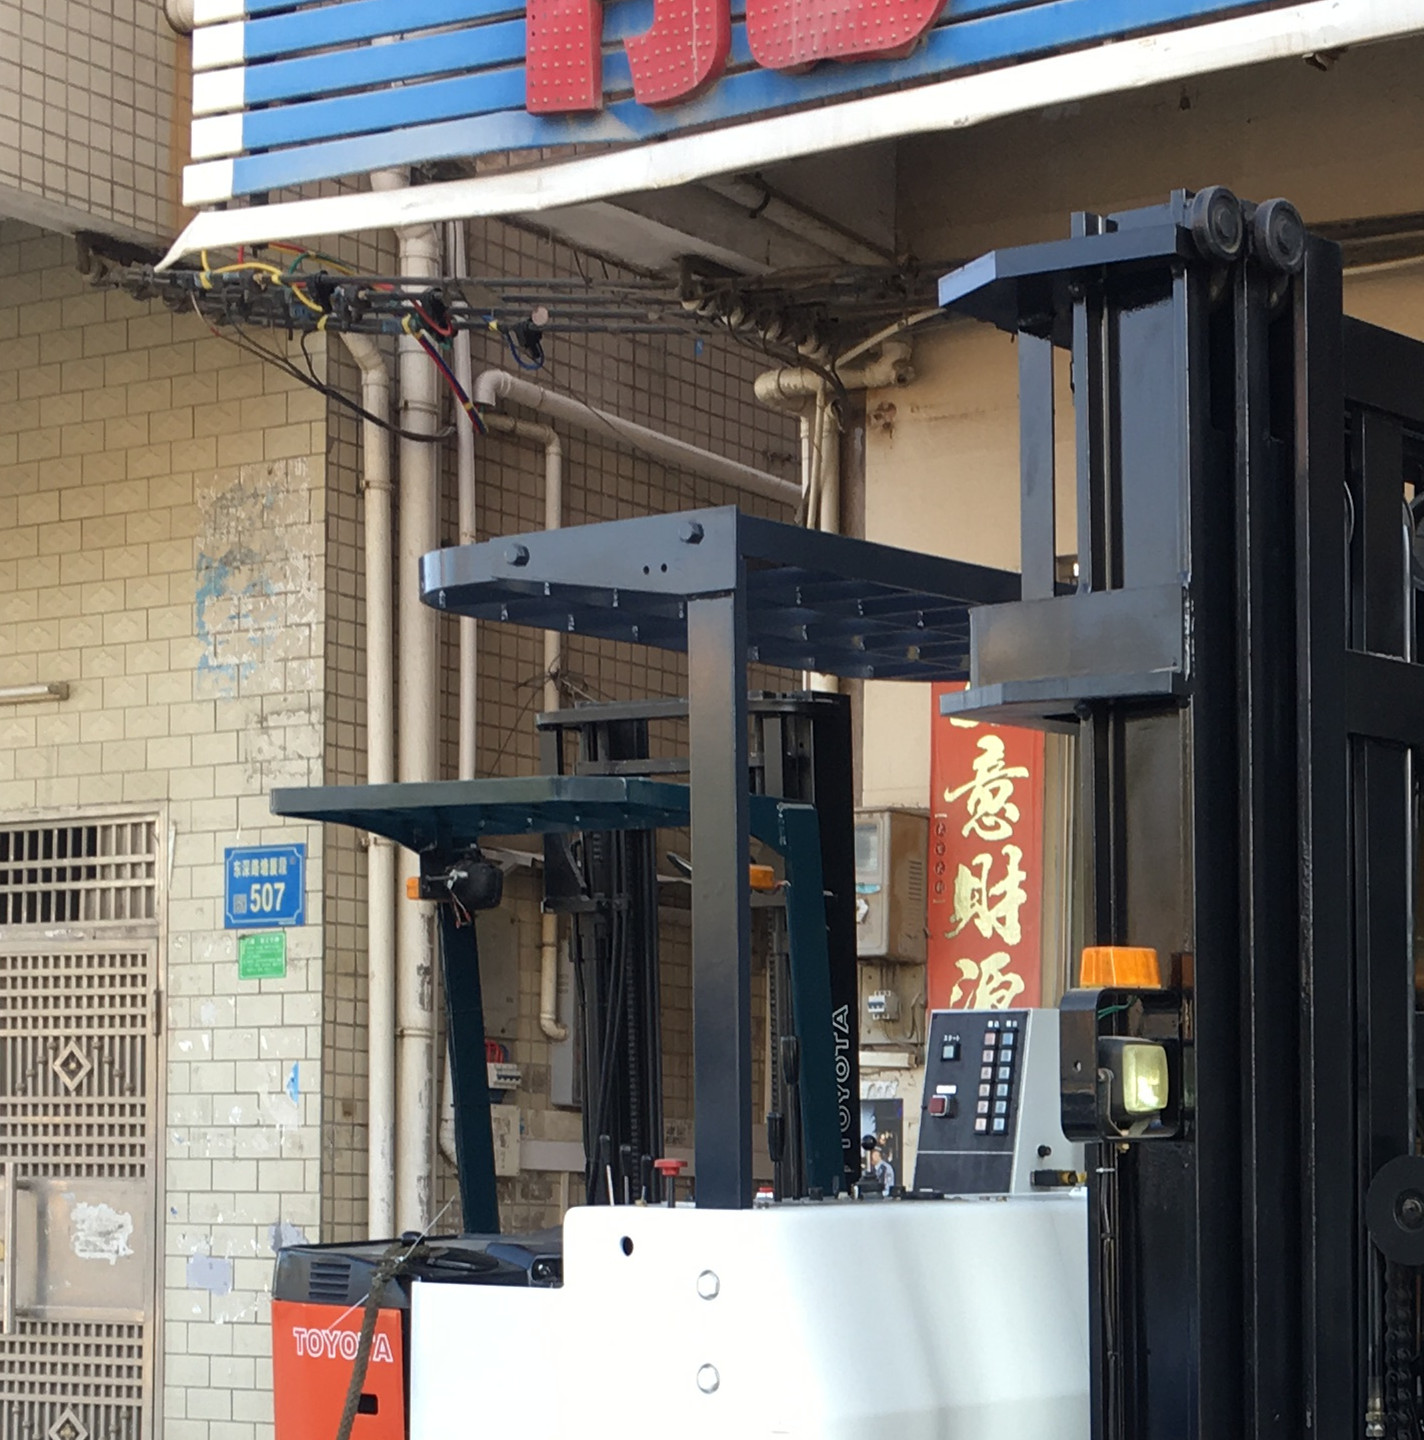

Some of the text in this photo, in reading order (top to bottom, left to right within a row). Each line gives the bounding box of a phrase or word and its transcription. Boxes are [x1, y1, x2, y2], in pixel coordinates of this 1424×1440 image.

[943, 716, 1029, 1009] 意財源
[250, 882, 286, 913] 507
[293, 1327, 394, 1363] TOYOA
